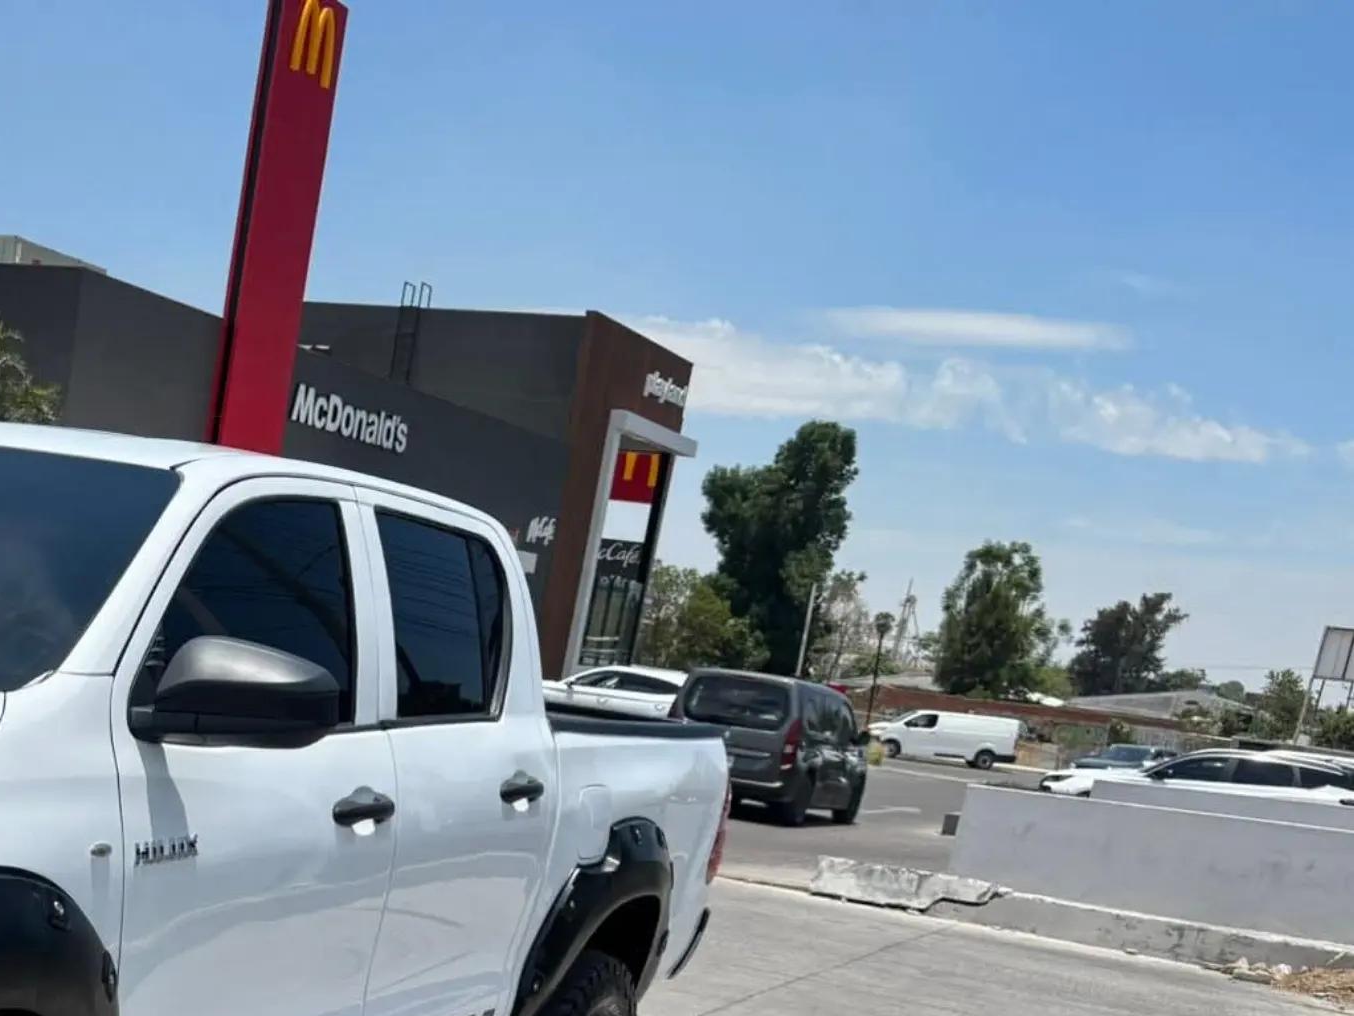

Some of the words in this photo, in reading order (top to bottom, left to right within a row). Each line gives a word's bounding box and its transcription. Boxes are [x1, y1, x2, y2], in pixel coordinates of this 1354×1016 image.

[291, 383, 408, 453] McDonald's
[597, 543, 640, 567] cCafé
[134, 834, 198, 866] HILUX
